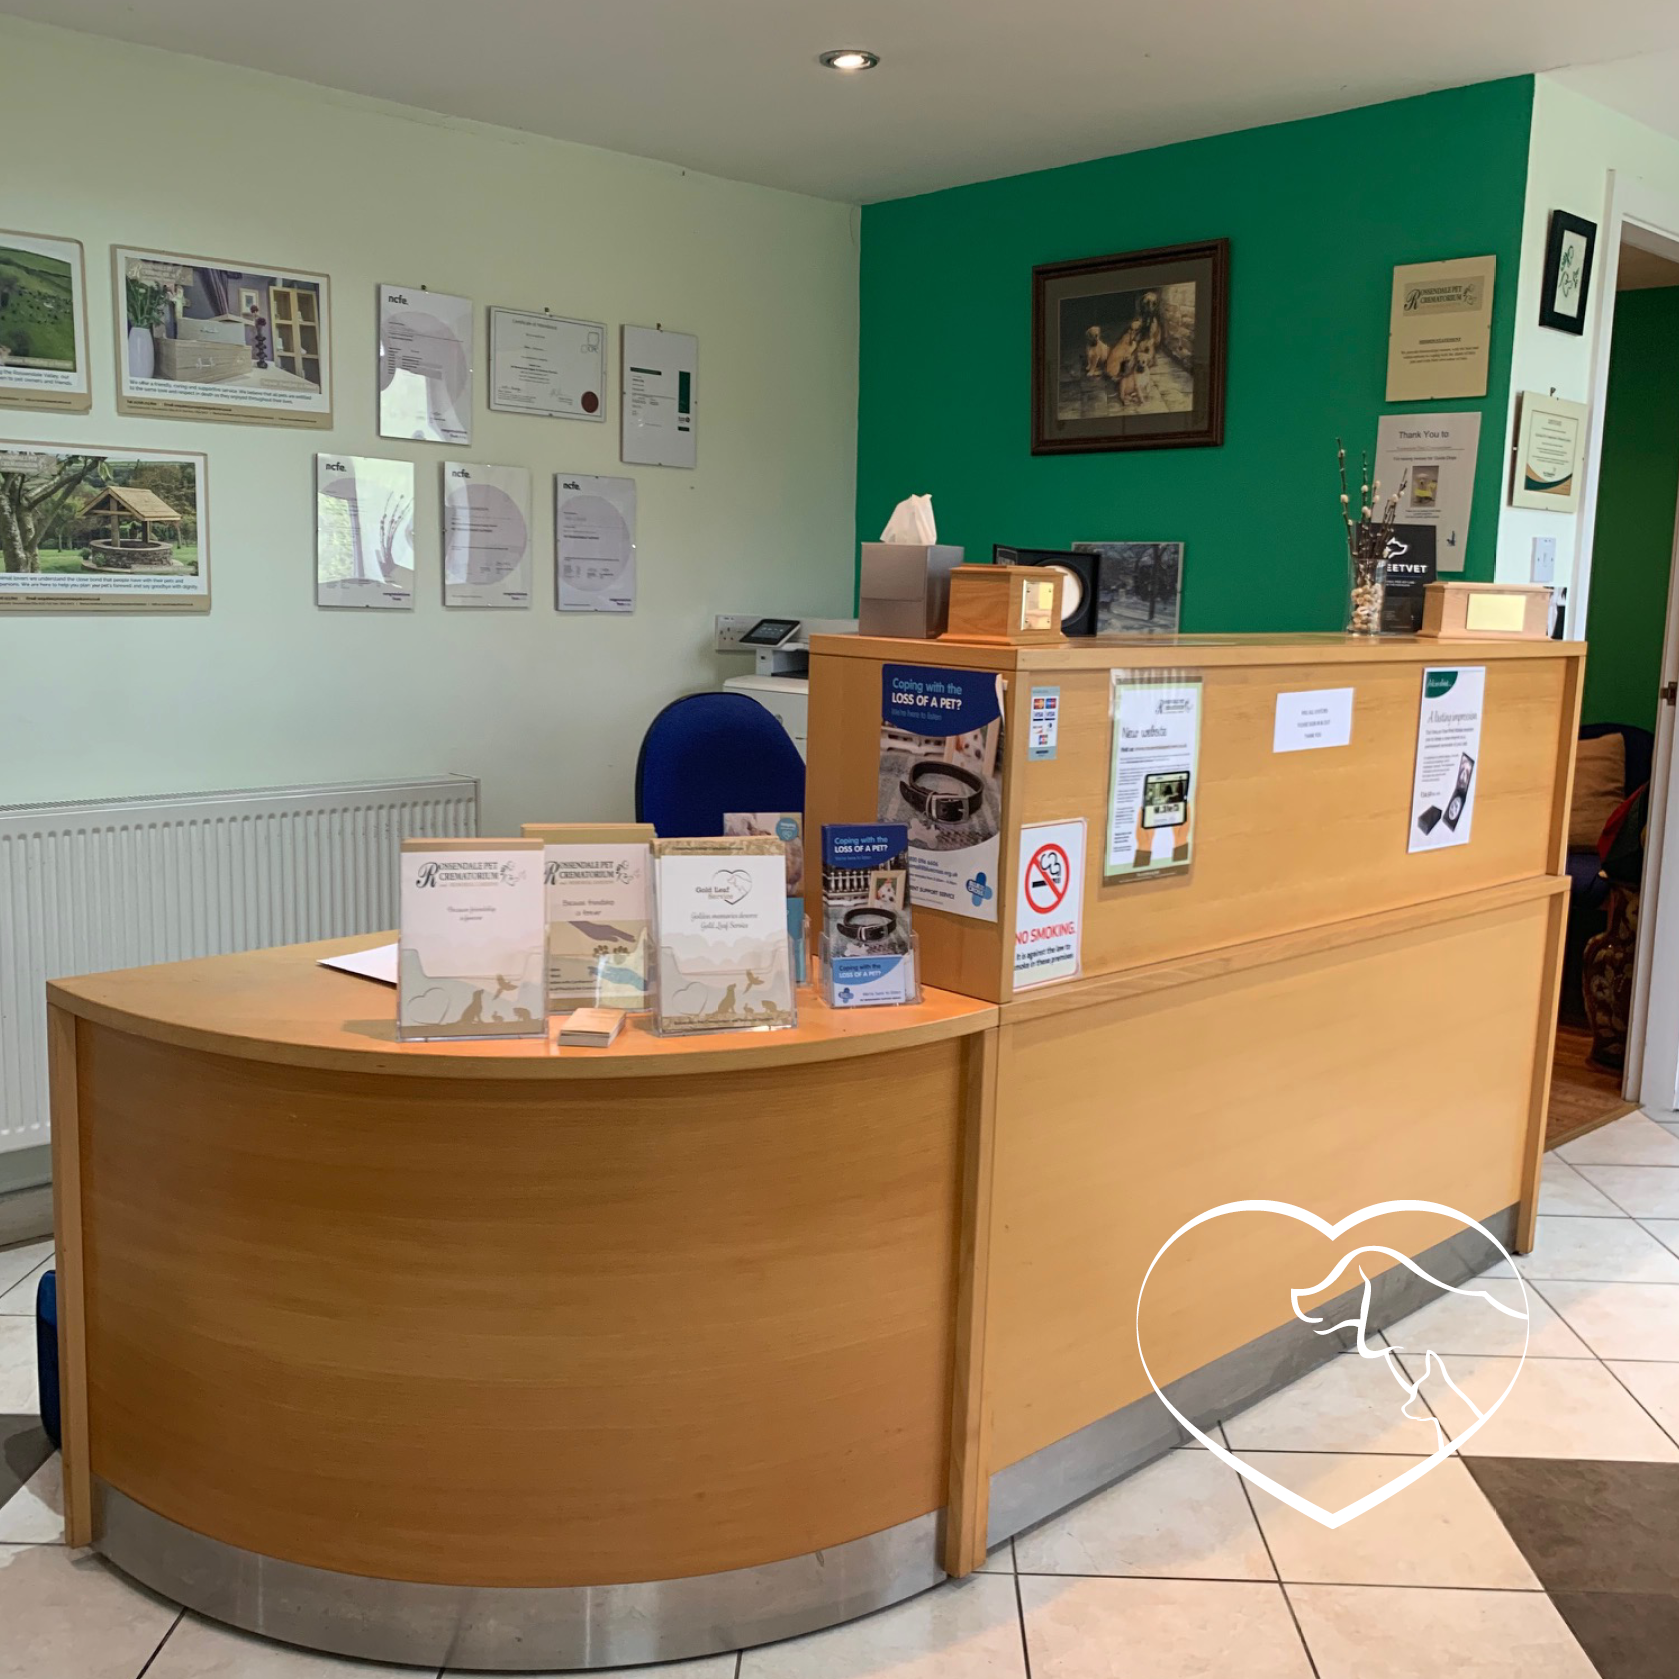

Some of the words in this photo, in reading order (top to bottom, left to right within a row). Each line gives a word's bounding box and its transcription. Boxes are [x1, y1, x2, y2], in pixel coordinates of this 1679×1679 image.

[1404, 287, 1451, 311] ROSSENDALE
[1420, 294, 1462, 304] CREMATORIUM
[1399, 431, 1421, 439] Thank
[1442, 430, 1449, 438] to
[892, 677, 923, 693] Coping
[926, 682, 944, 693] with
[947, 683, 962, 695] the
[892, 692, 914, 705] LOSS
[916, 694, 929, 707] OF
[930, 696, 938, 708] A
[940, 697, 962, 711] PET?
[834, 837, 859, 845] Coping
[834, 845, 853, 853] LOSS
[854, 845, 864, 853] OF
[872, 844, 888, 852] PET?
[416, 862, 482, 888] ROSSENDALE
[483, 862, 498, 870] PET
[439, 872, 498, 881] CREMATORIUM
[544, 861, 599, 885] ROSSENDALE
[600, 861, 614, 869] PET
[559, 871, 614, 879] CREMATORIUM
[920, 887, 939, 895] SUPPORT
[940, 891, 955, 900] SERVICE
[1015, 930, 1029, 944] NO
[1031, 921, 1076, 942] SMOKING.
[1027, 949, 1046, 960] against
[1036, 958, 1050, 966] these
[1051, 953, 1074, 965] premises
